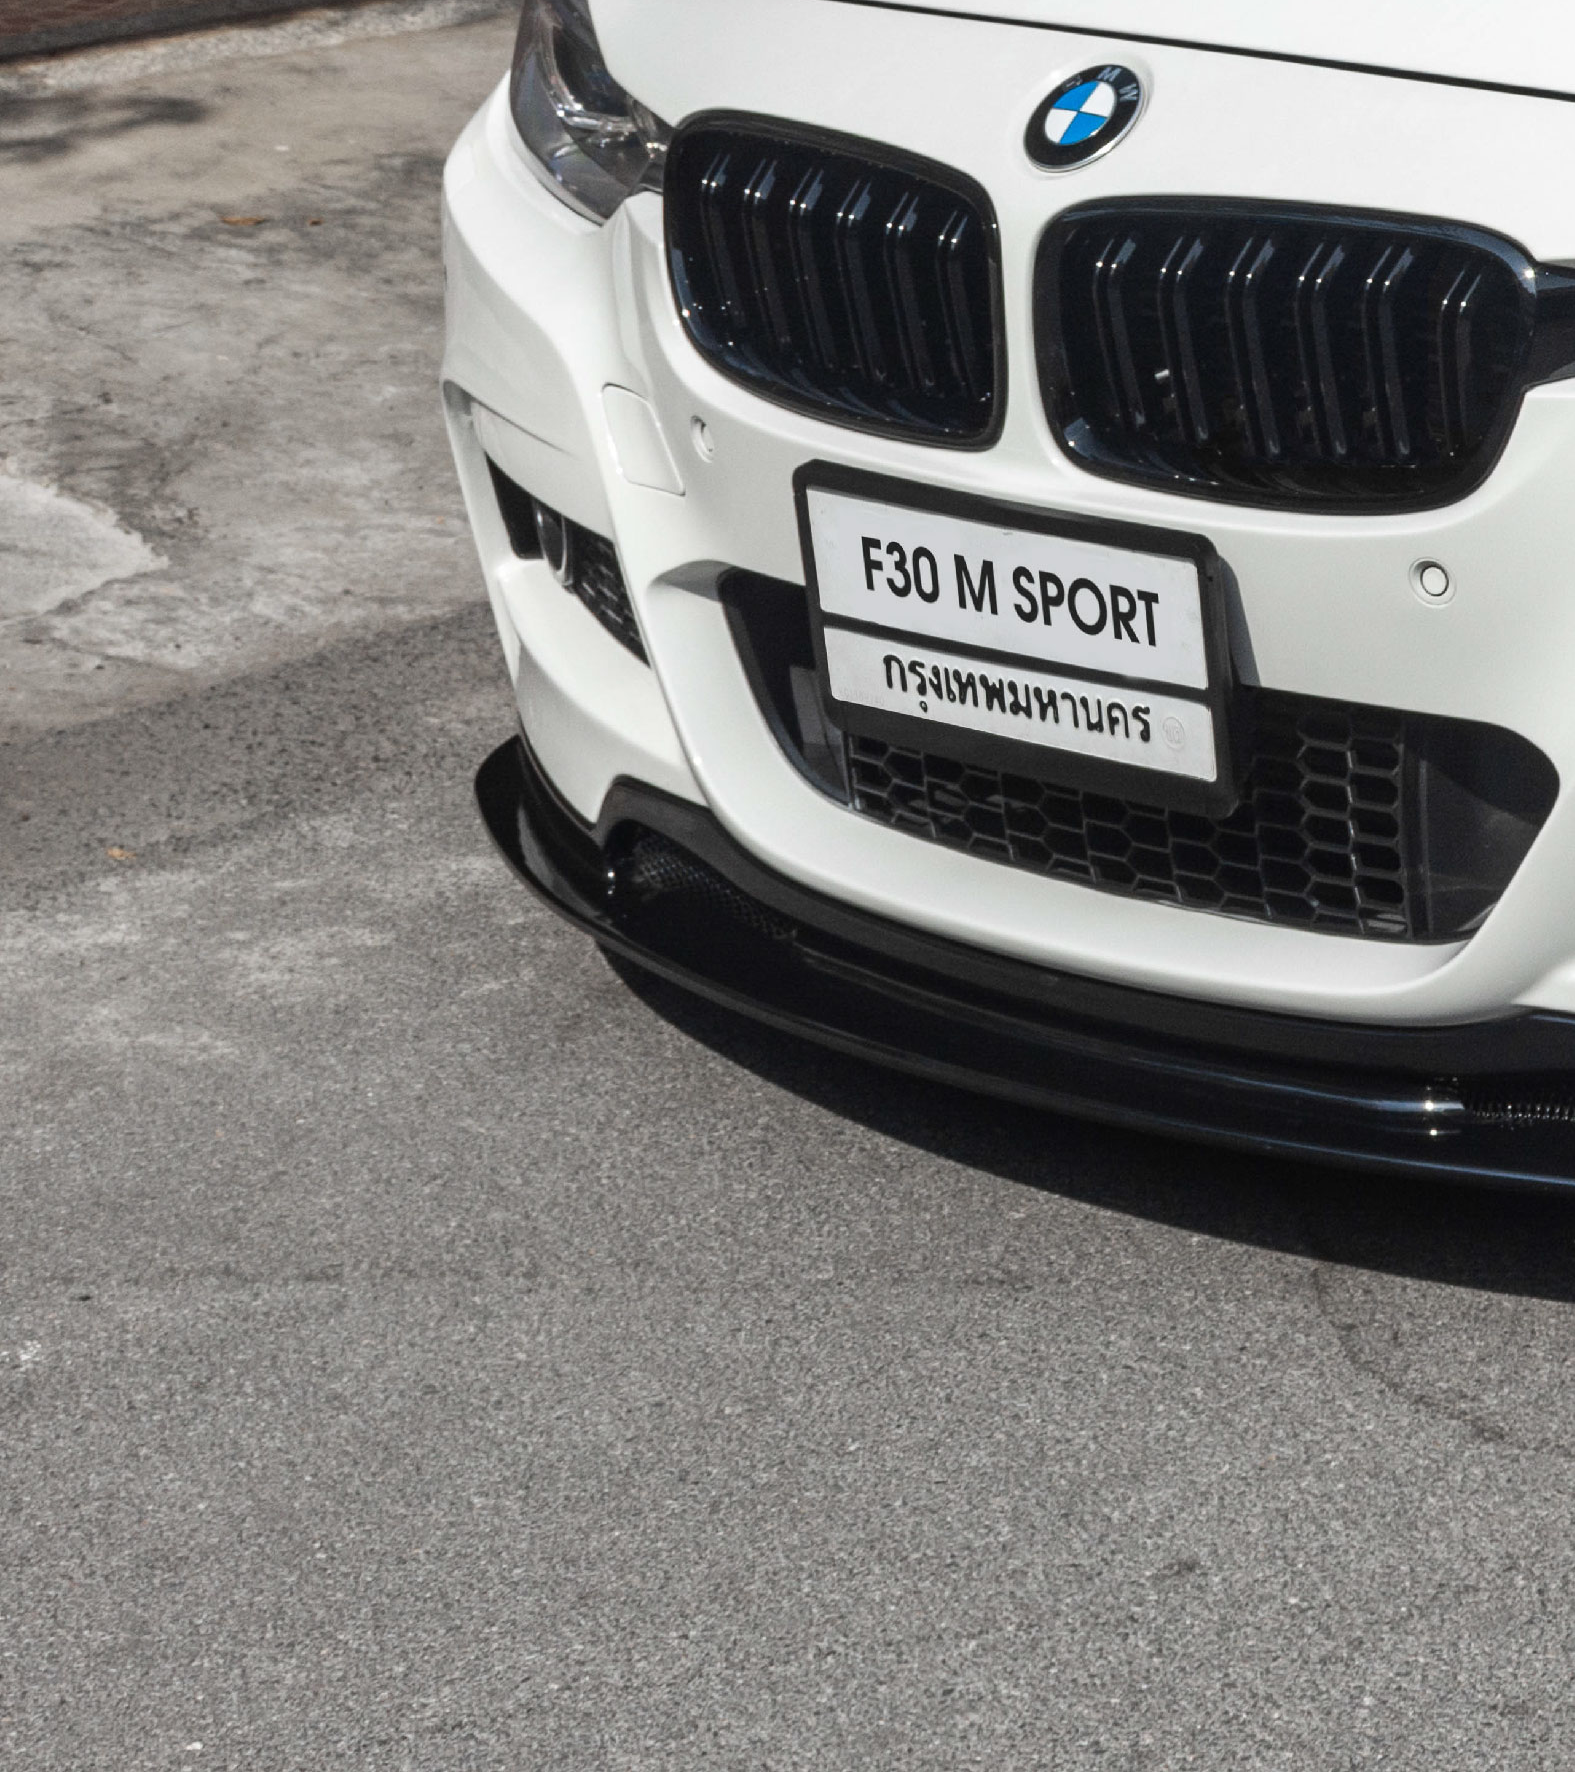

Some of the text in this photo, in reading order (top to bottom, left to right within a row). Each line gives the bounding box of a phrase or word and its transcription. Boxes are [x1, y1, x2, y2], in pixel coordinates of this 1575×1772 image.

[861, 536, 1159, 647] F30 M SPORT
[882, 653, 1151, 743] กรุงเทพมหานคร
